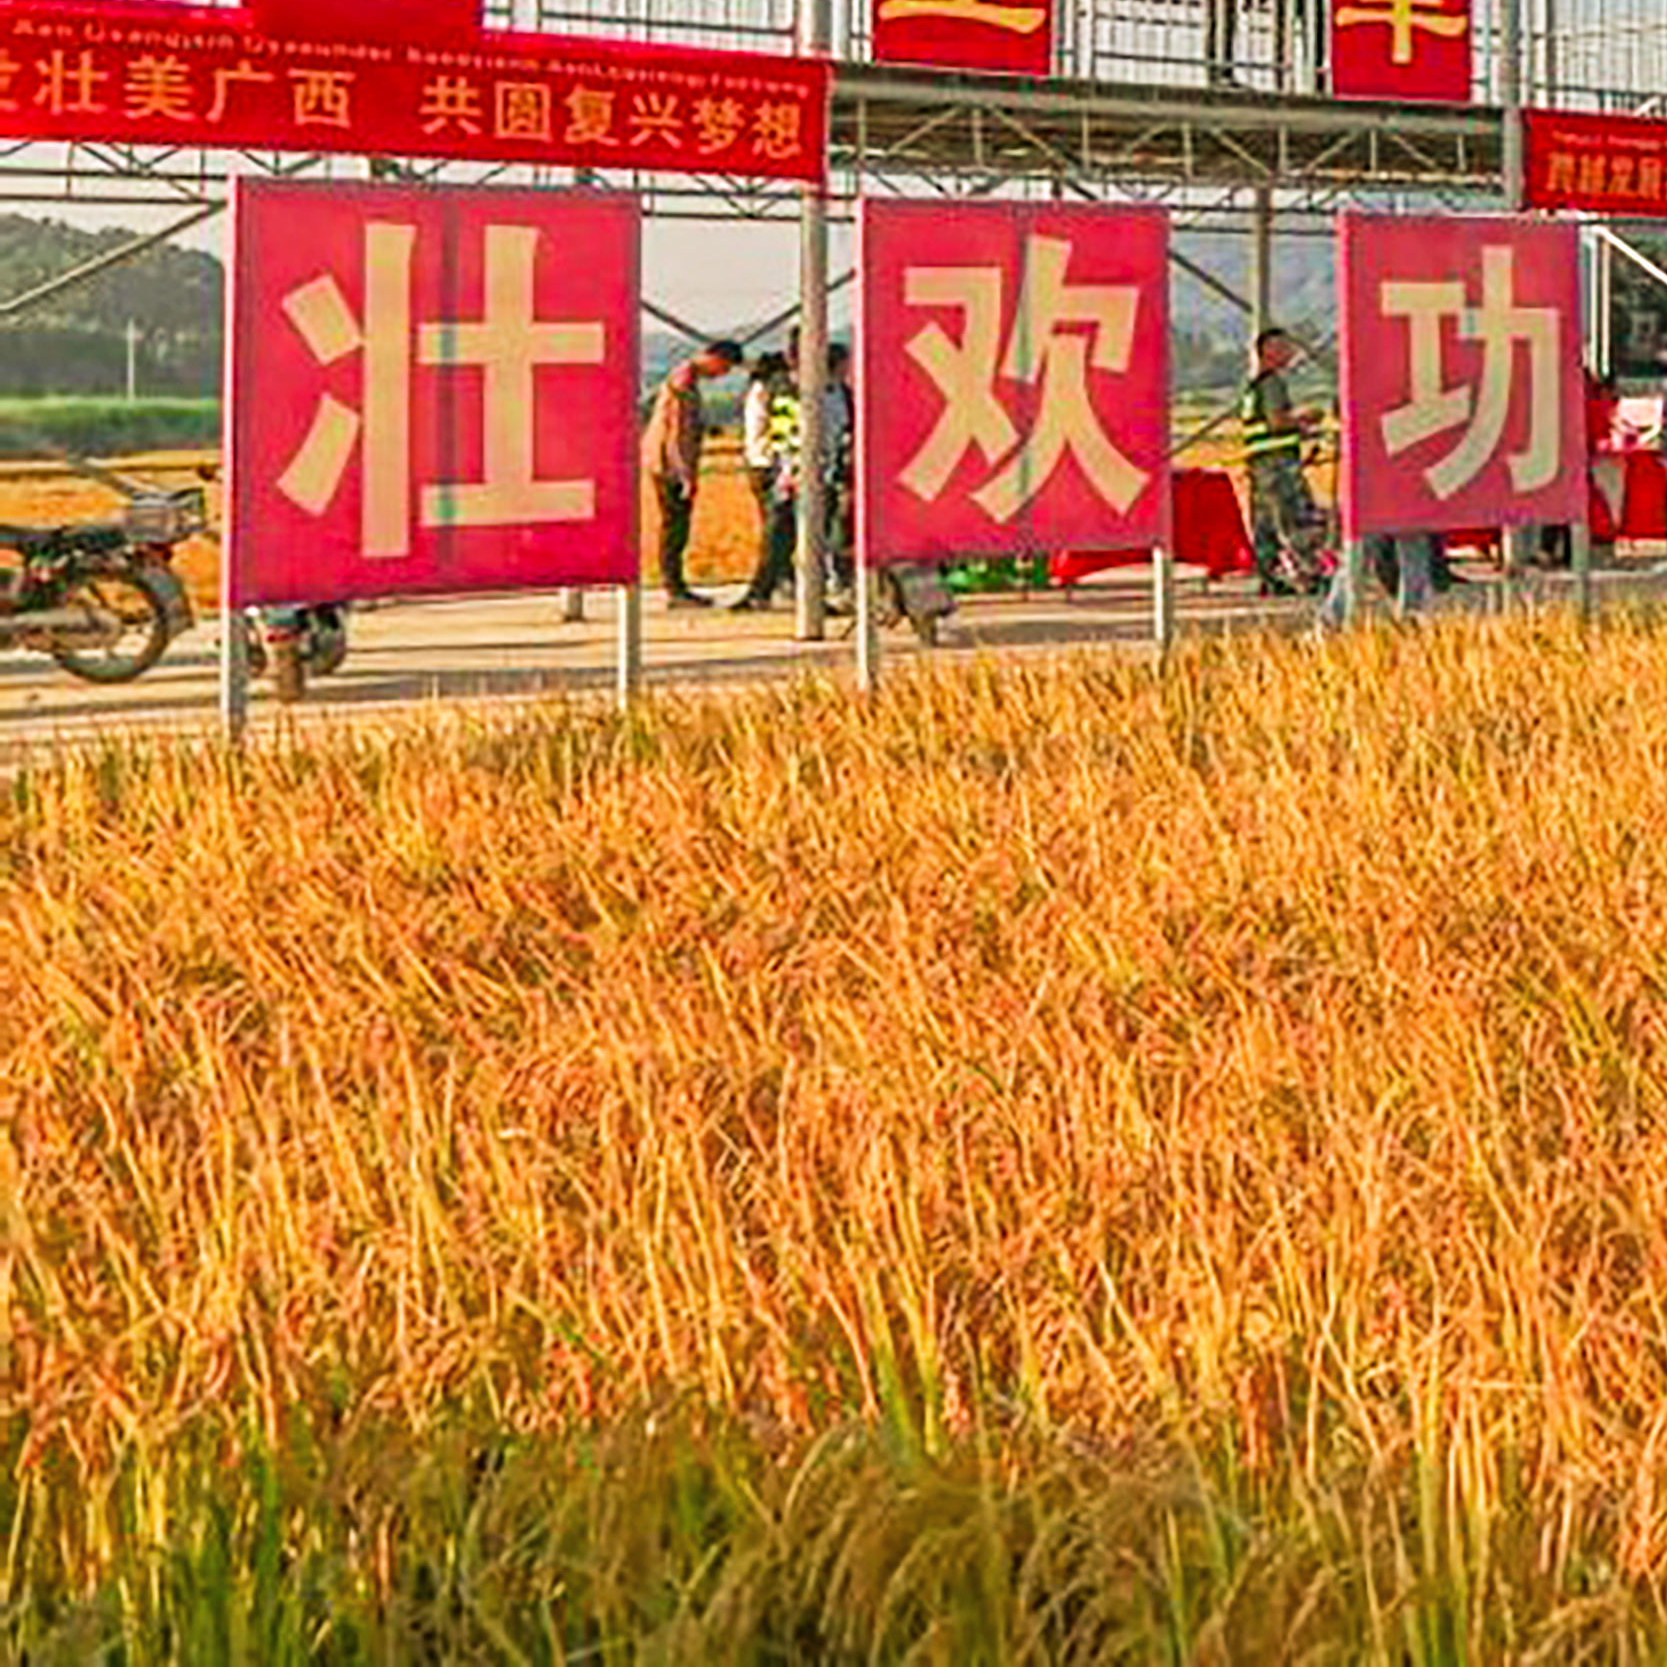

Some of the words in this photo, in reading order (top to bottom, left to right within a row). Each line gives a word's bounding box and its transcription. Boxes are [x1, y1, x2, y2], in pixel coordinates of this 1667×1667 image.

[418, 74, 803, 161] 共圆复兴梦想
[276, 222, 605, 558] 壮
[897, 236, 1152, 522] 欢
[1381, 245, 1562, 501] 功
